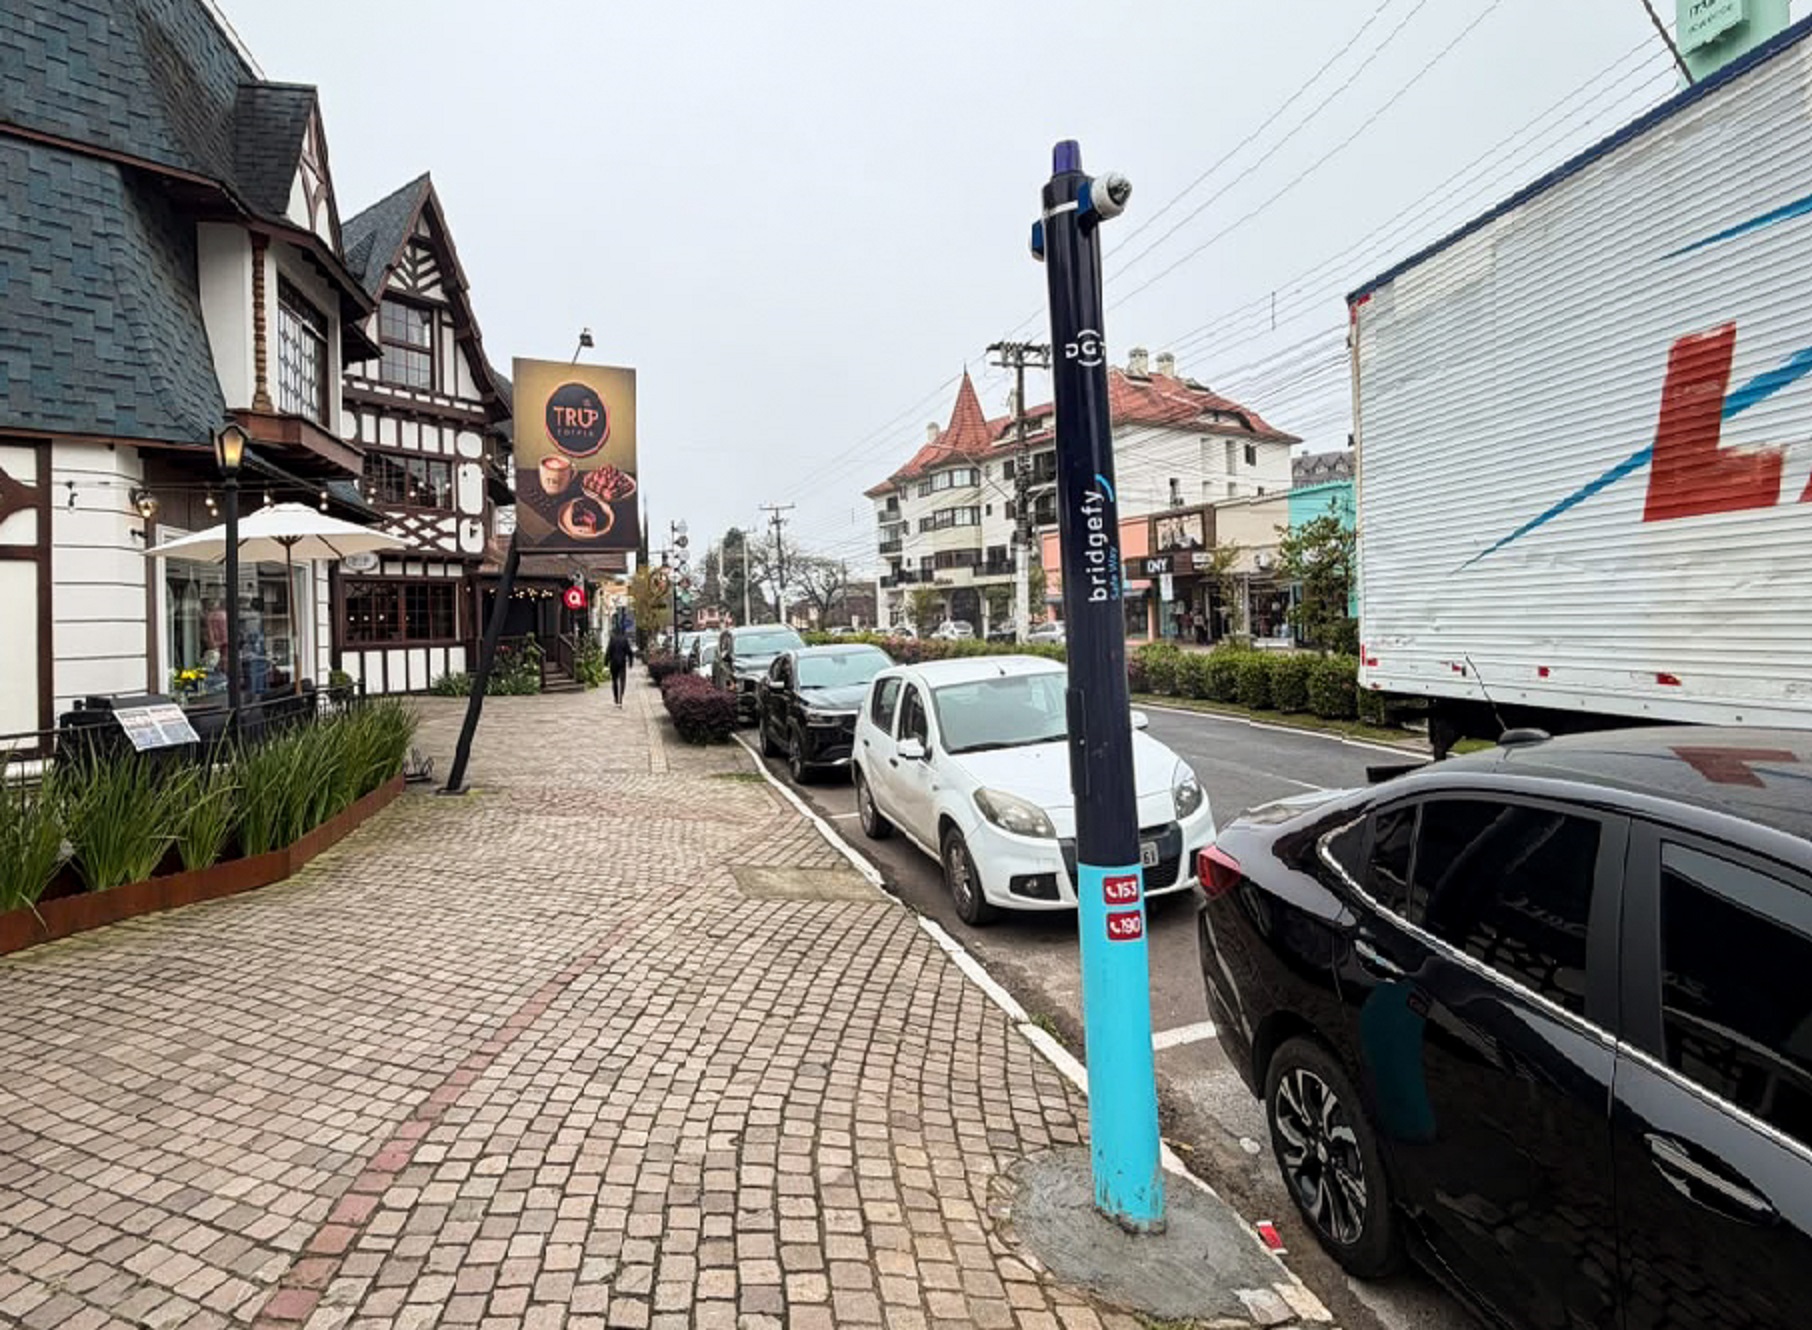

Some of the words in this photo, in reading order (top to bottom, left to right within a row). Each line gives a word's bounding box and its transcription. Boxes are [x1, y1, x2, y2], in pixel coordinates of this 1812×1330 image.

[1642, 318, 1812, 523] L
[1081, 489, 1109, 603] bridgefy
[1107, 545, 1118, 572] Way
[1109, 574, 1120, 601] Safe
[1115, 880, 1138, 899] 153
[1120, 916, 1141, 935] 190
